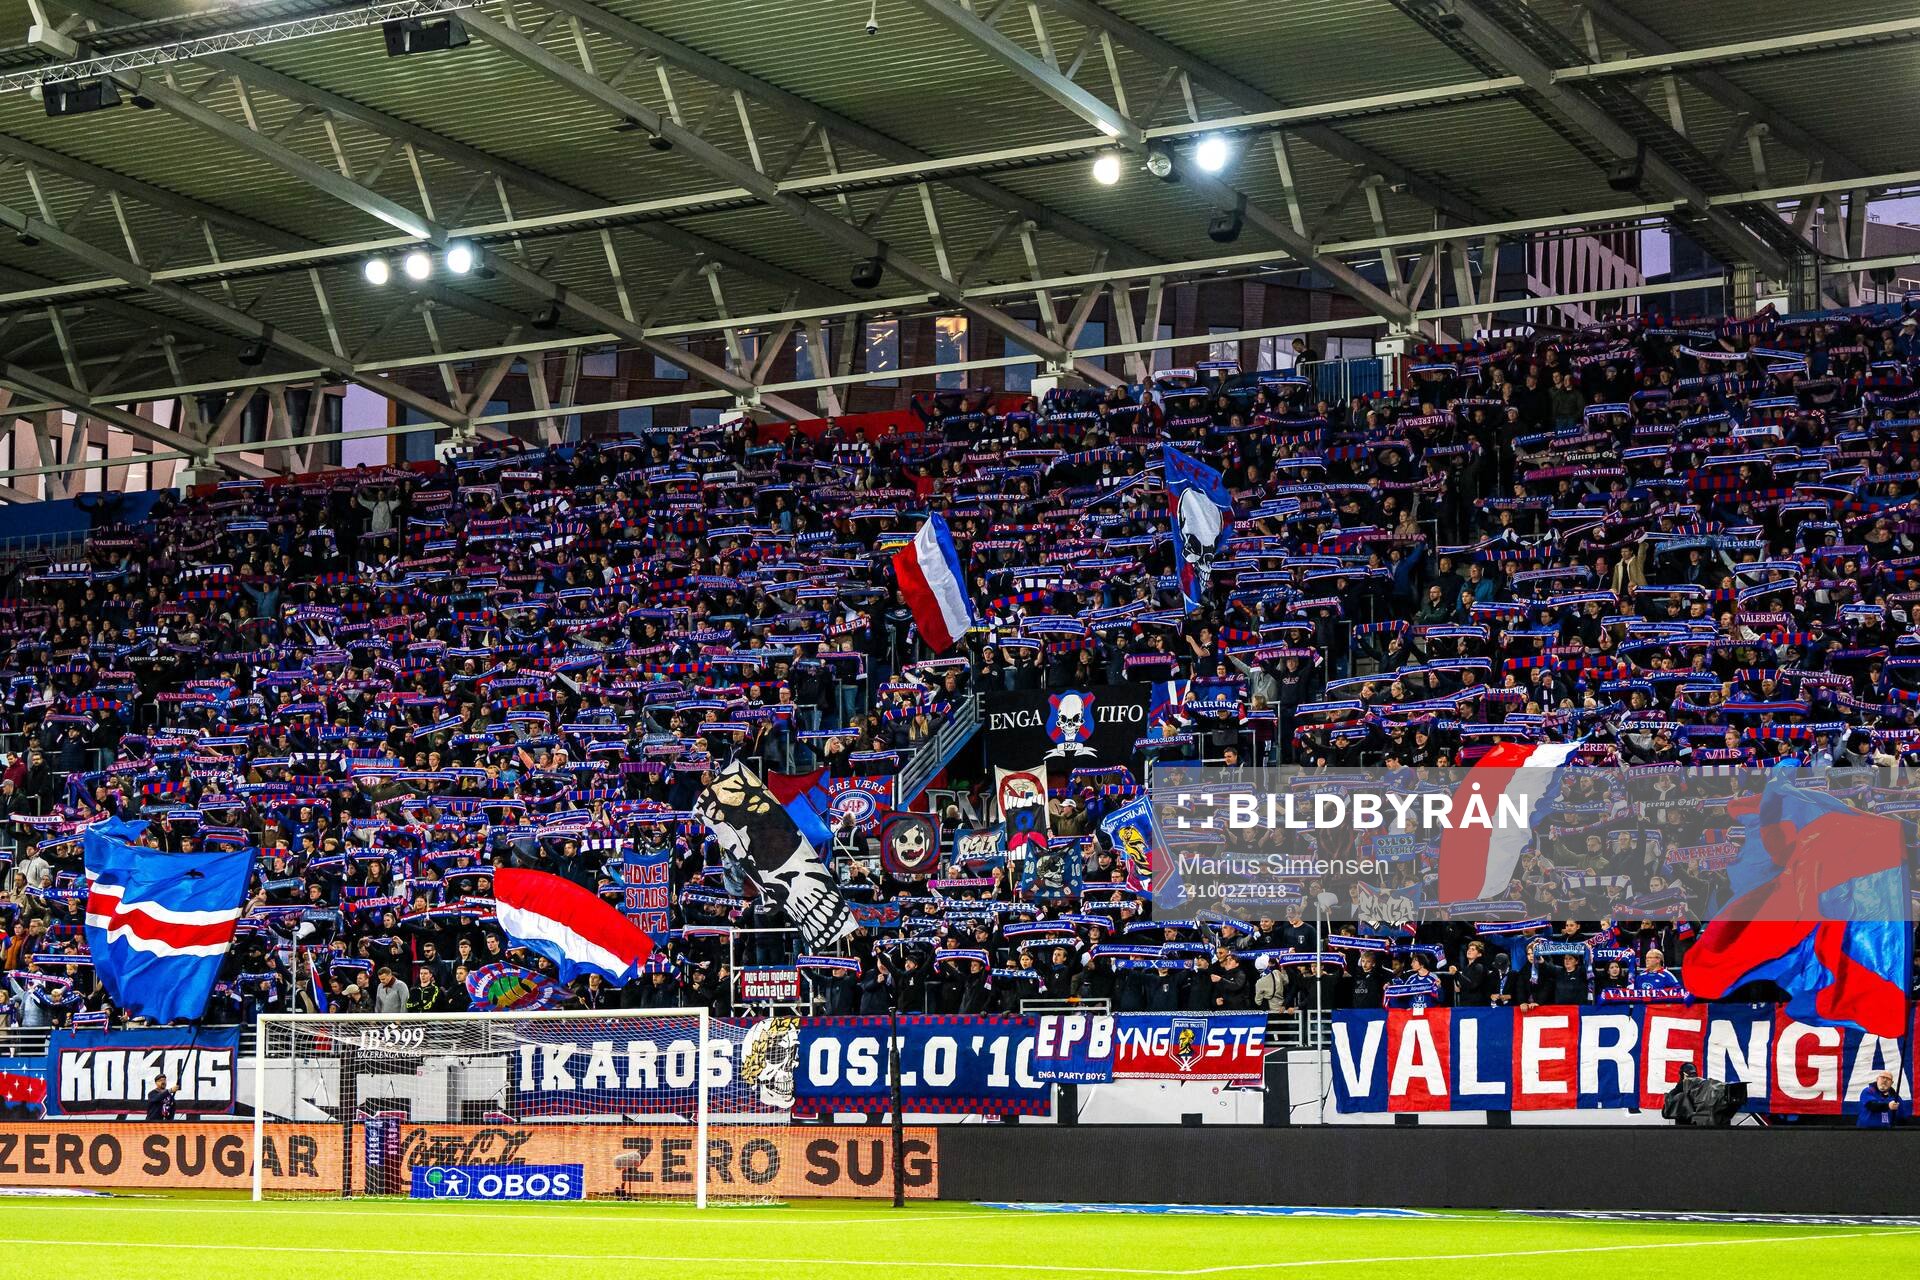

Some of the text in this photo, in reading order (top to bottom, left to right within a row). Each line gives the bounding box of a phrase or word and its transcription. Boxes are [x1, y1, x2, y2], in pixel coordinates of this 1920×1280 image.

[989, 704, 1144, 731] ENGA TIFO
[855, 779, 885, 794] VÆRE
[624, 863, 668, 885] HOVED
[626, 886, 668, 908] STADS
[1038, 1016, 1114, 1058] EPB
[1116, 1026, 1266, 1062] YNG STE
[1332, 1008, 1913, 1101] VÅLERENGA
[61, 1049, 231, 1102] KOKOS
[519, 1039, 733, 1092] IKAROS
[808, 1036, 958, 1087] OSLO
[1038, 1071, 1106, 1081] ENGA PARTY BOYS
[143, 1134, 320, 1178] SUGAR
[622, 1137, 781, 1185] ZERO
[478, 1173, 570, 1198] OBOS
